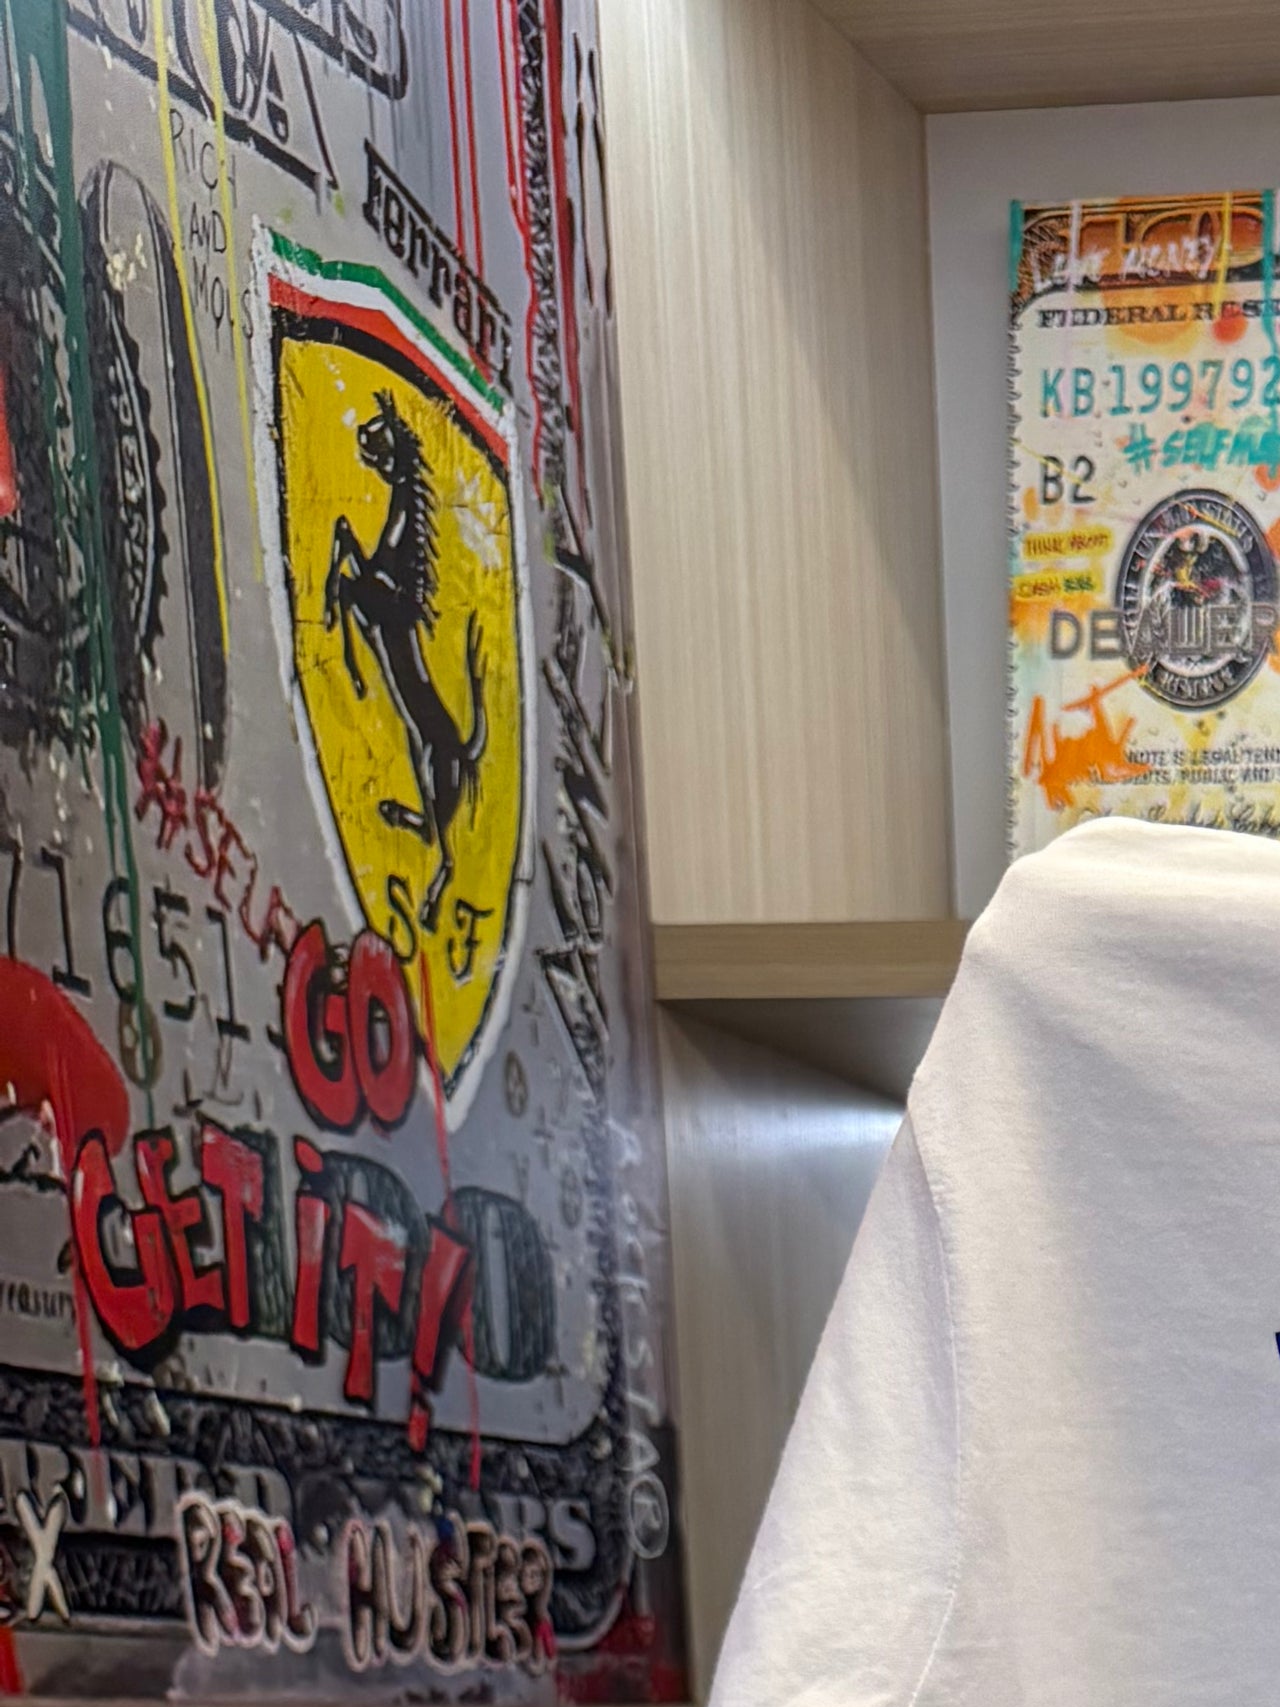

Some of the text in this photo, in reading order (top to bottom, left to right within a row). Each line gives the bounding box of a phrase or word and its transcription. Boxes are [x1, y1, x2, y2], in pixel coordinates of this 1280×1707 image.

[1037, 302, 1187, 330] FEDERAL
[1040, 455, 1097, 505] B2
[280, 918, 416, 1136] GO
[68, 1122, 272, 1366] GET
